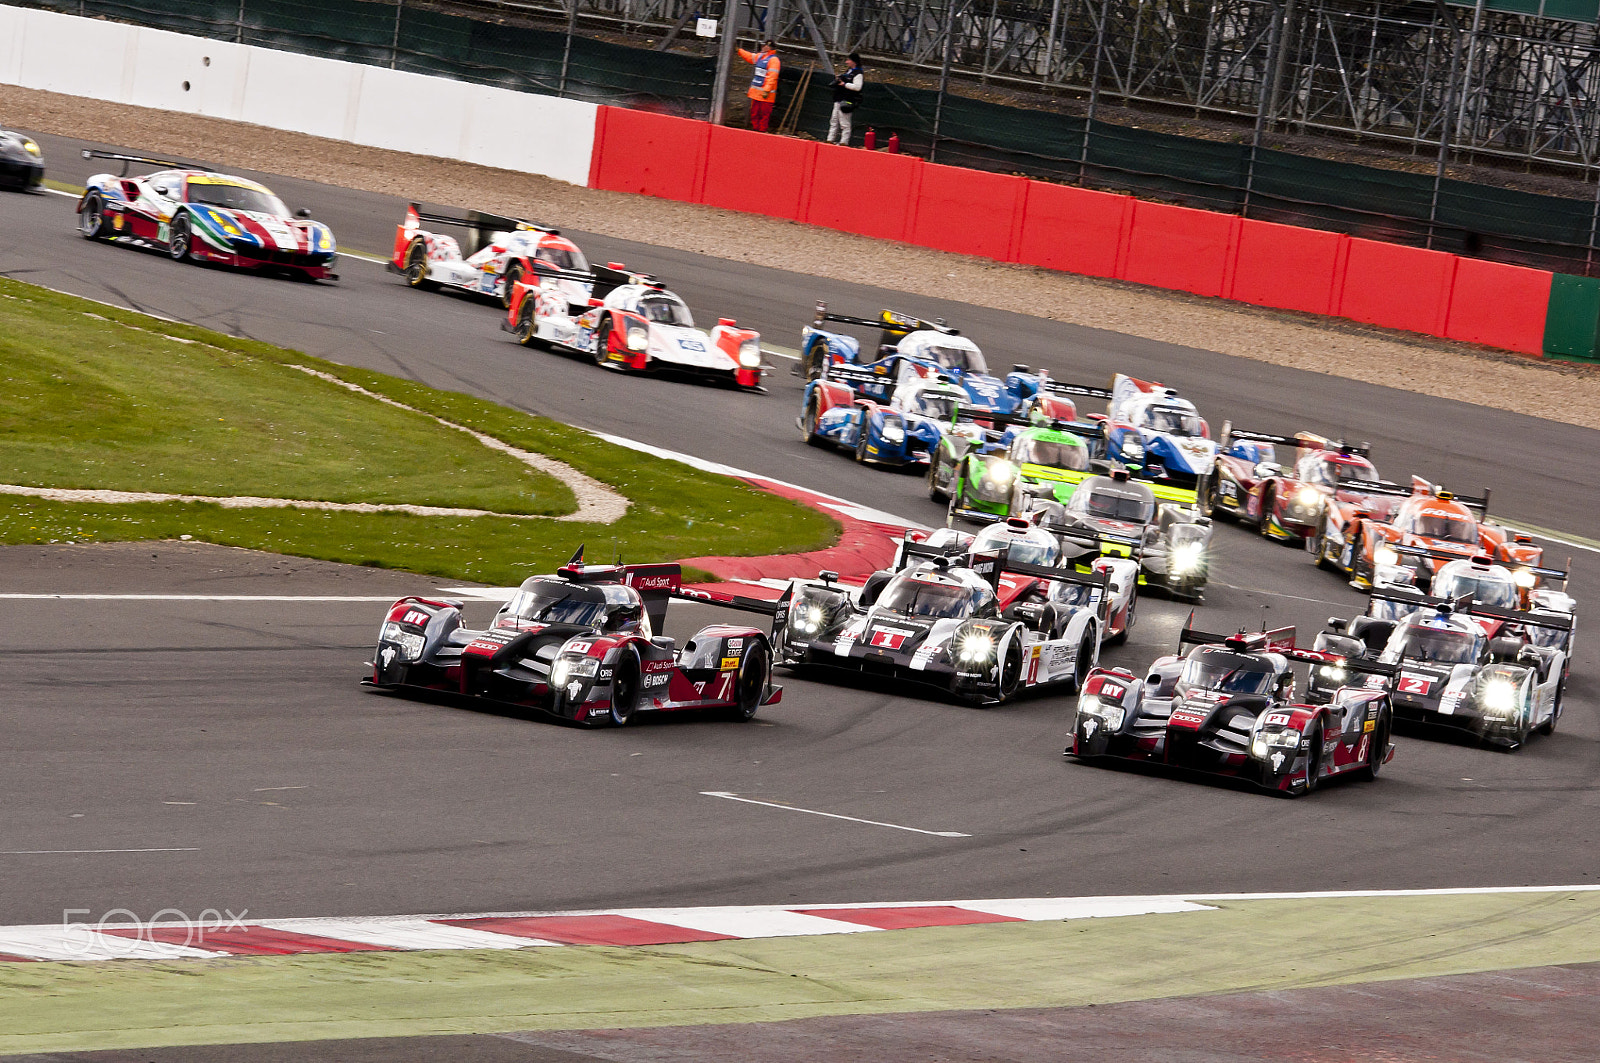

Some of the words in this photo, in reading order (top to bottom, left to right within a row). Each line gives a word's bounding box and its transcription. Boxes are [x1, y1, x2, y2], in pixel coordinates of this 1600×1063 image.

[645, 578, 656, 587] Audi
[656, 577, 670, 588] Sport
[403, 610, 430, 626] HY
[569, 642, 588, 652] P1
[878, 633, 894, 647] 1
[600, 669, 613, 678] ORIS
[651, 674, 669, 686] BOSCH
[718, 672, 731, 700] 7
[1101, 683, 1125, 697] HY
[1404, 679, 1423, 693] 2
[1270, 715, 1285, 724] P1
[1358, 734, 1368, 762] 8
